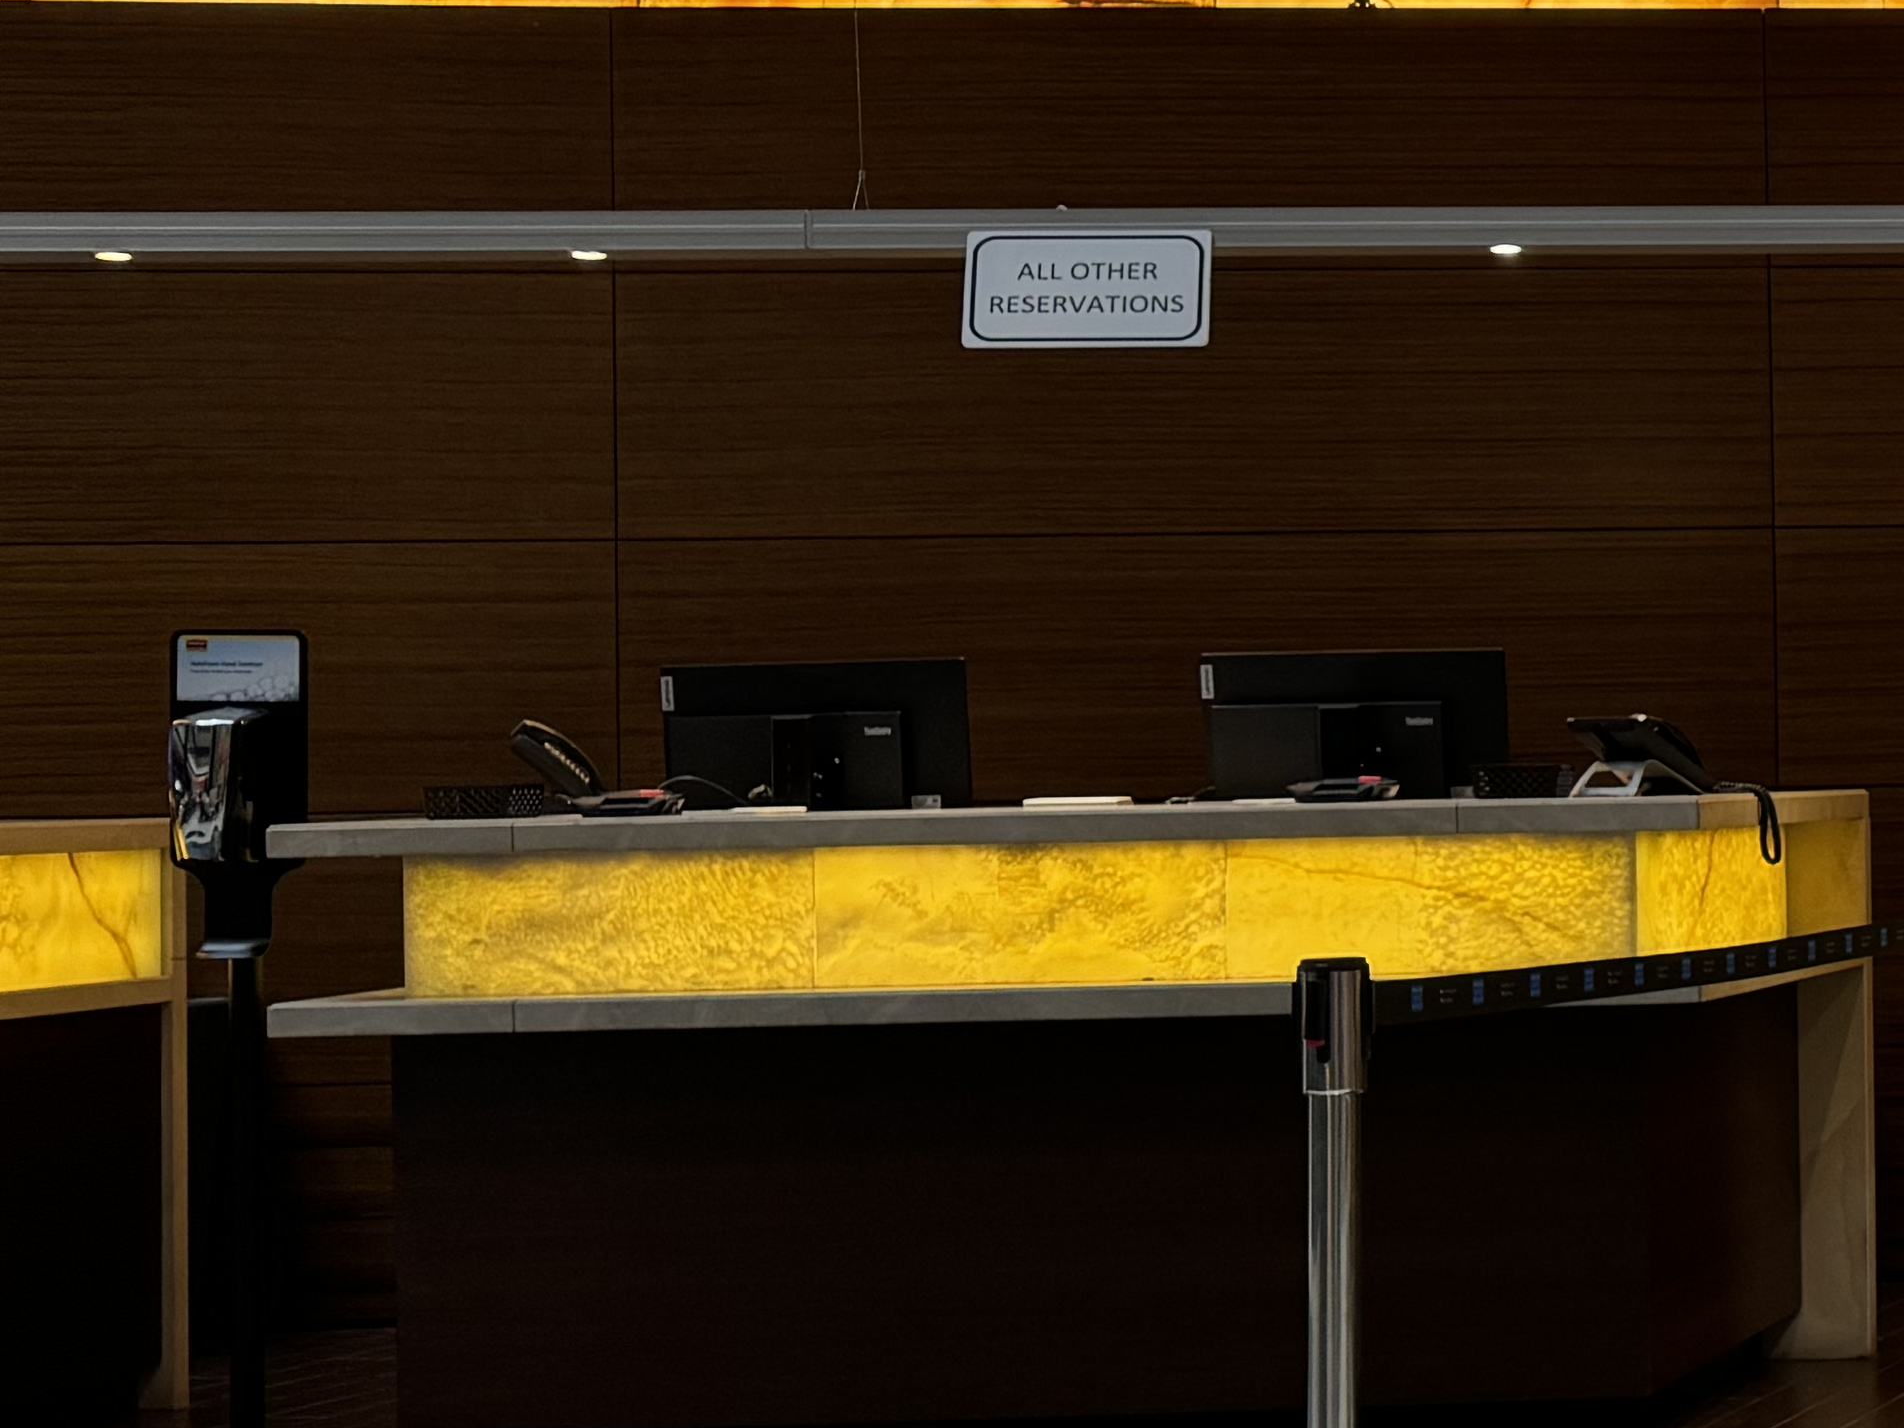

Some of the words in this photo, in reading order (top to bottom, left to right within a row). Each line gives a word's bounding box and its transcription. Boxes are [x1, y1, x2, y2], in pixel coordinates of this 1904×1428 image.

[1017, 263, 1062, 281] ALL
[1070, 262, 1158, 281] OTHER
[989, 294, 1184, 314] RESERVATIONS
